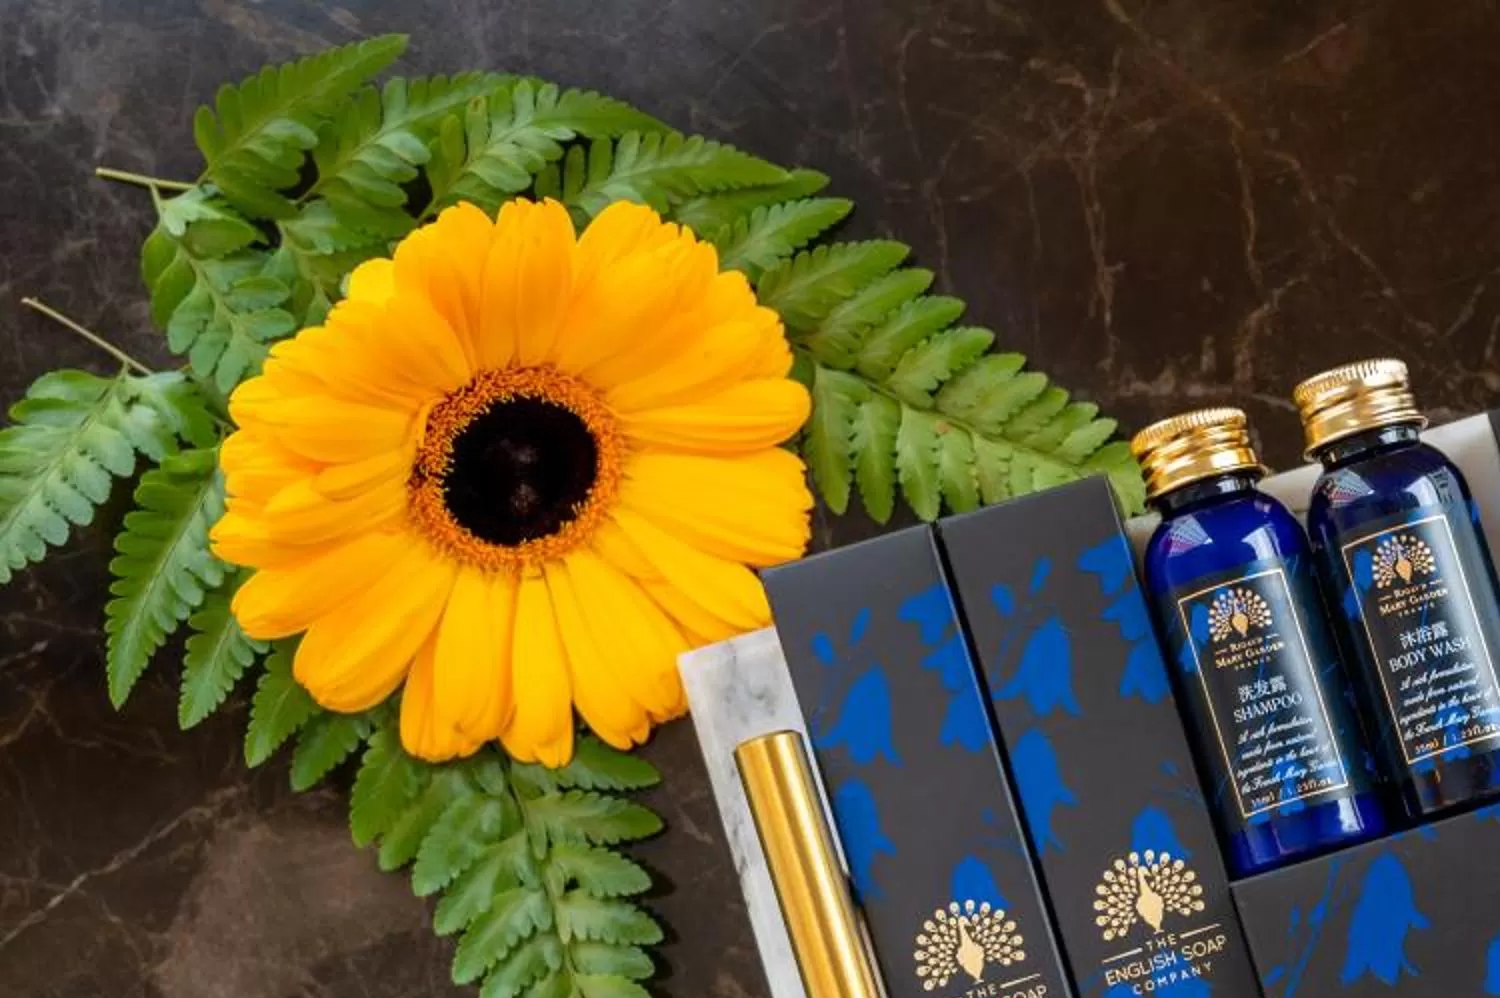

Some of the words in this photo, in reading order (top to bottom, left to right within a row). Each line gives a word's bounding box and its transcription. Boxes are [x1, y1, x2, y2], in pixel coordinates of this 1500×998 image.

[1389, 647, 1426, 672] BODY
[1429, 636, 1471, 657] WASH
[1234, 692, 1302, 723] SHAMPOO
[1146, 934, 1177, 950] THE
[1105, 952, 1177, 986] ENGLISH
[1181, 935, 1226, 960] SOAP
[1133, 961, 1212, 995] COMPANY
